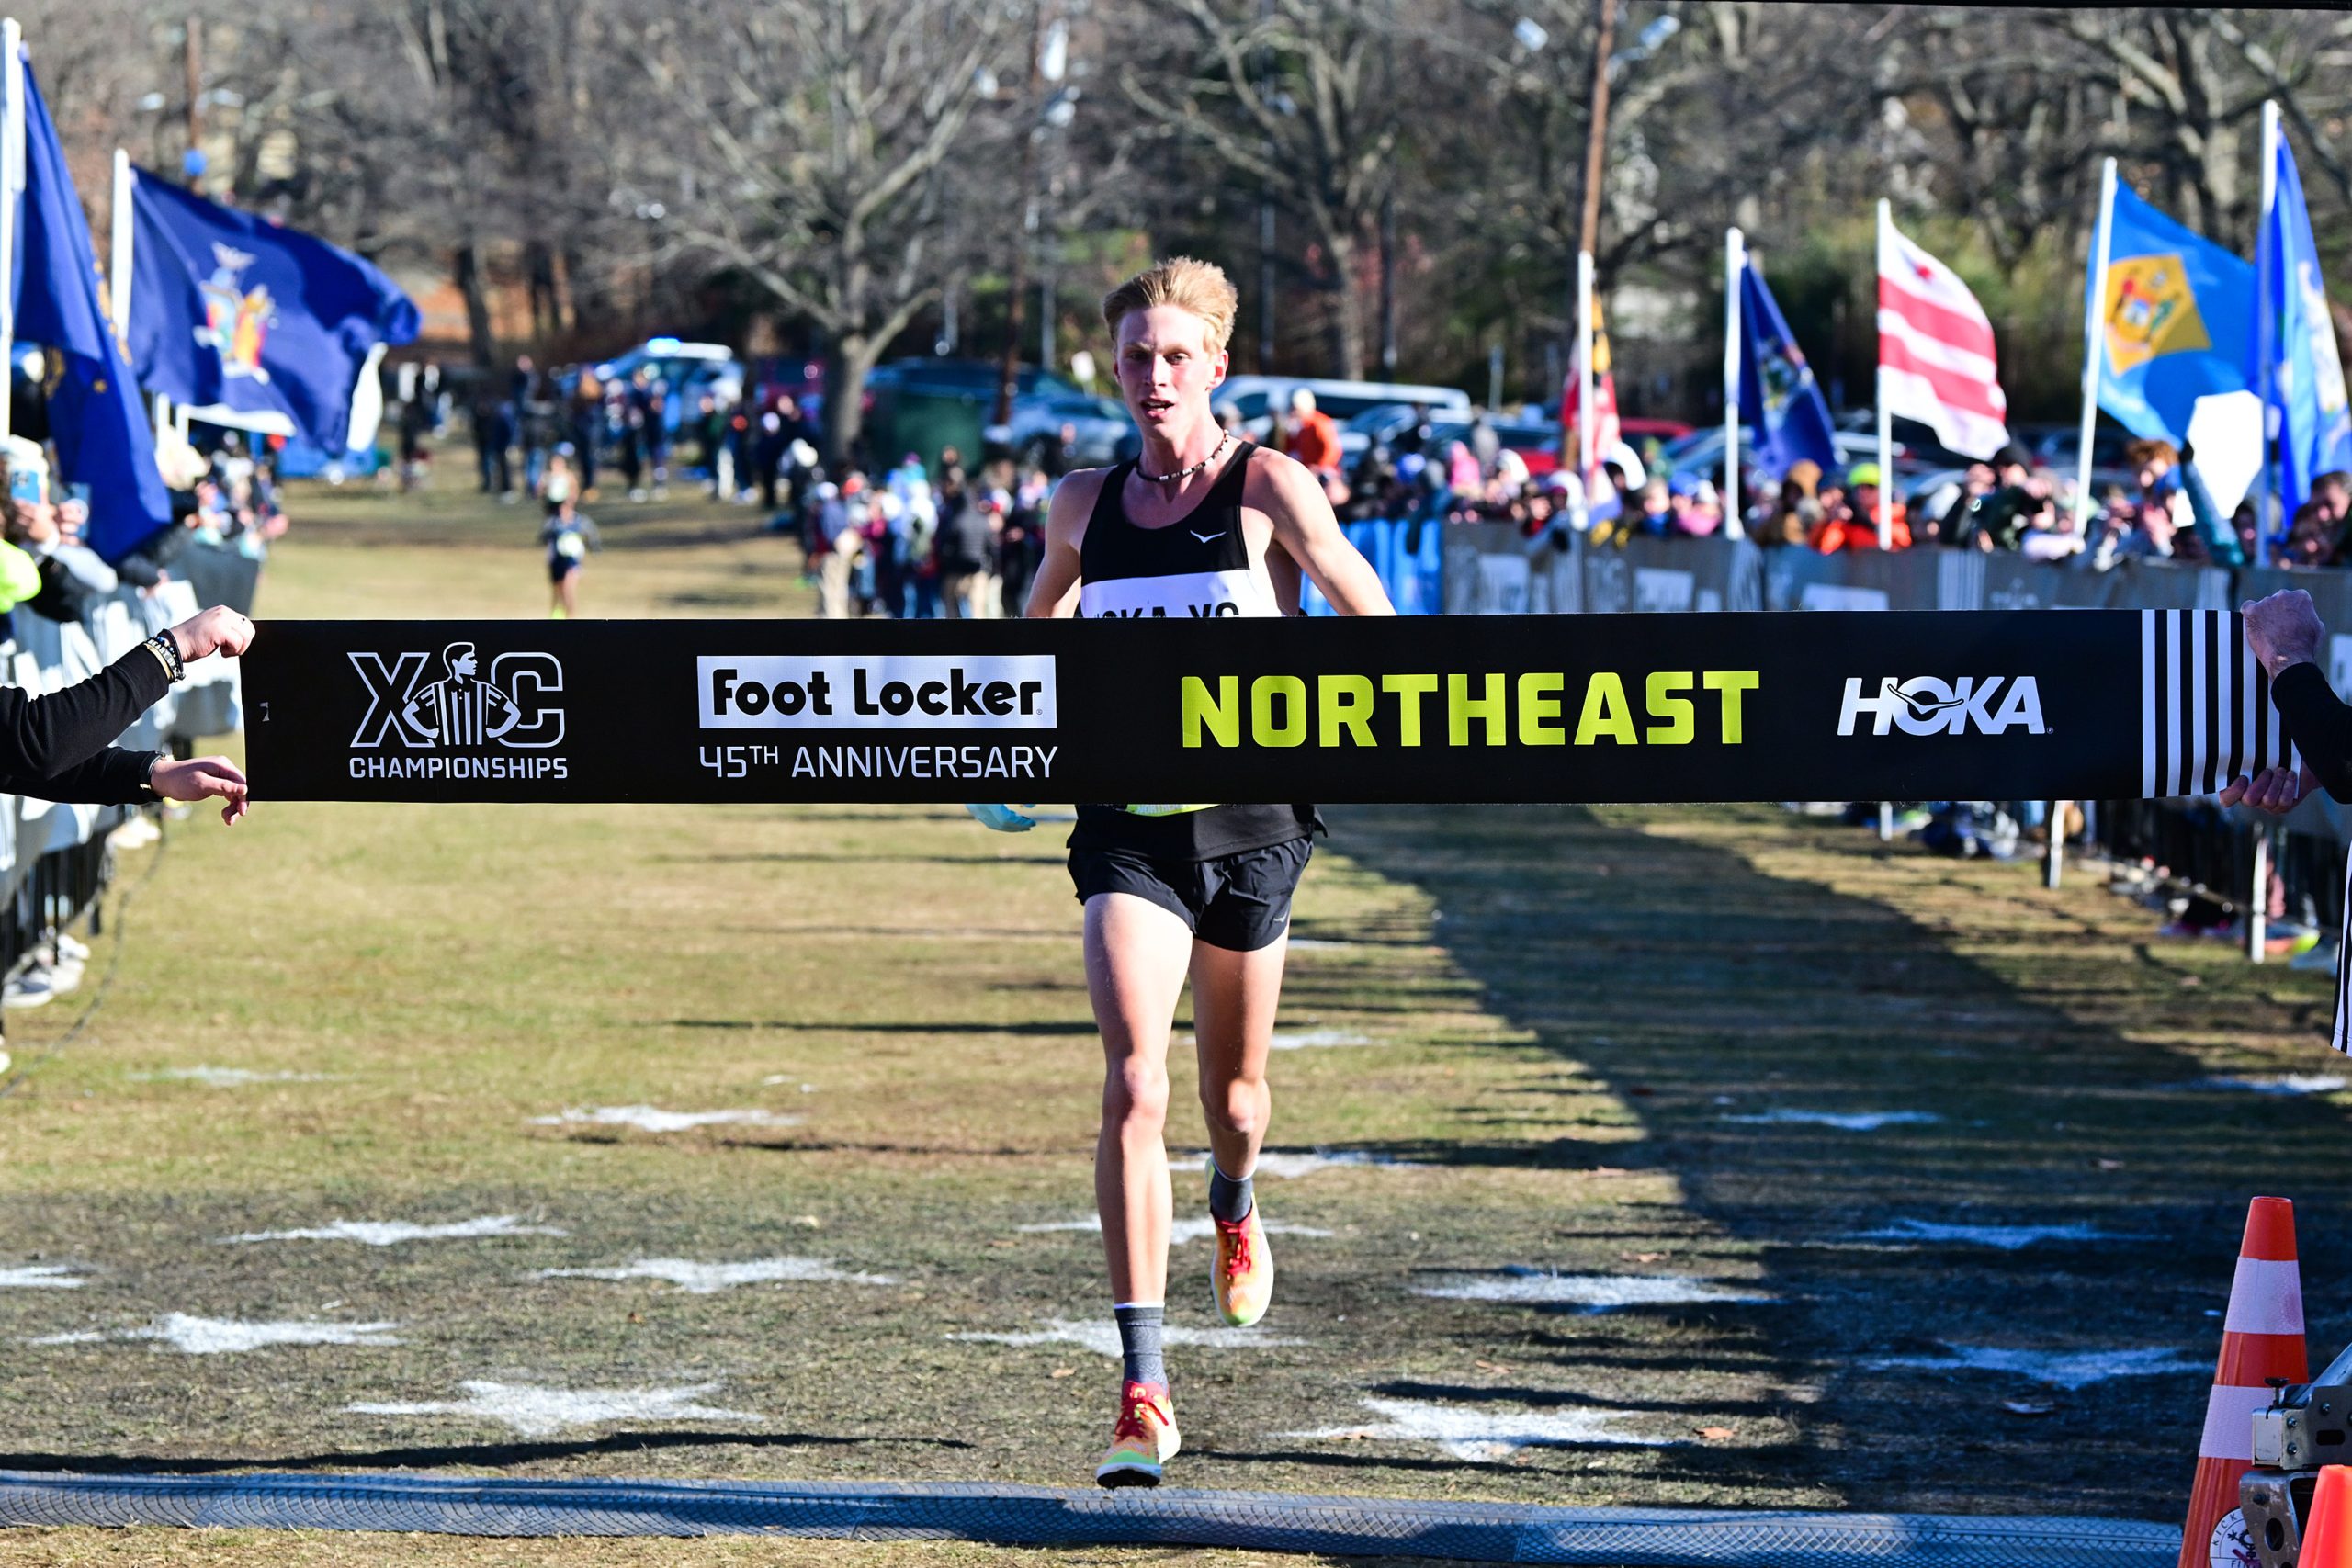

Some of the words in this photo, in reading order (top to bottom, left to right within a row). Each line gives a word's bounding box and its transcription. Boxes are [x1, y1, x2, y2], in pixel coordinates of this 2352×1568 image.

[713, 669, 832, 716] Foot
[854, 668, 1042, 716] Locker
[1182, 671, 1760, 748] NORTHEAST
[1838, 676, 2046, 736] HOKA
[349, 757, 568, 779] CHAMPIONSHIPS
[699, 745, 779, 778] 45TH
[791, 746, 1058, 778] ANNIVERSARY
